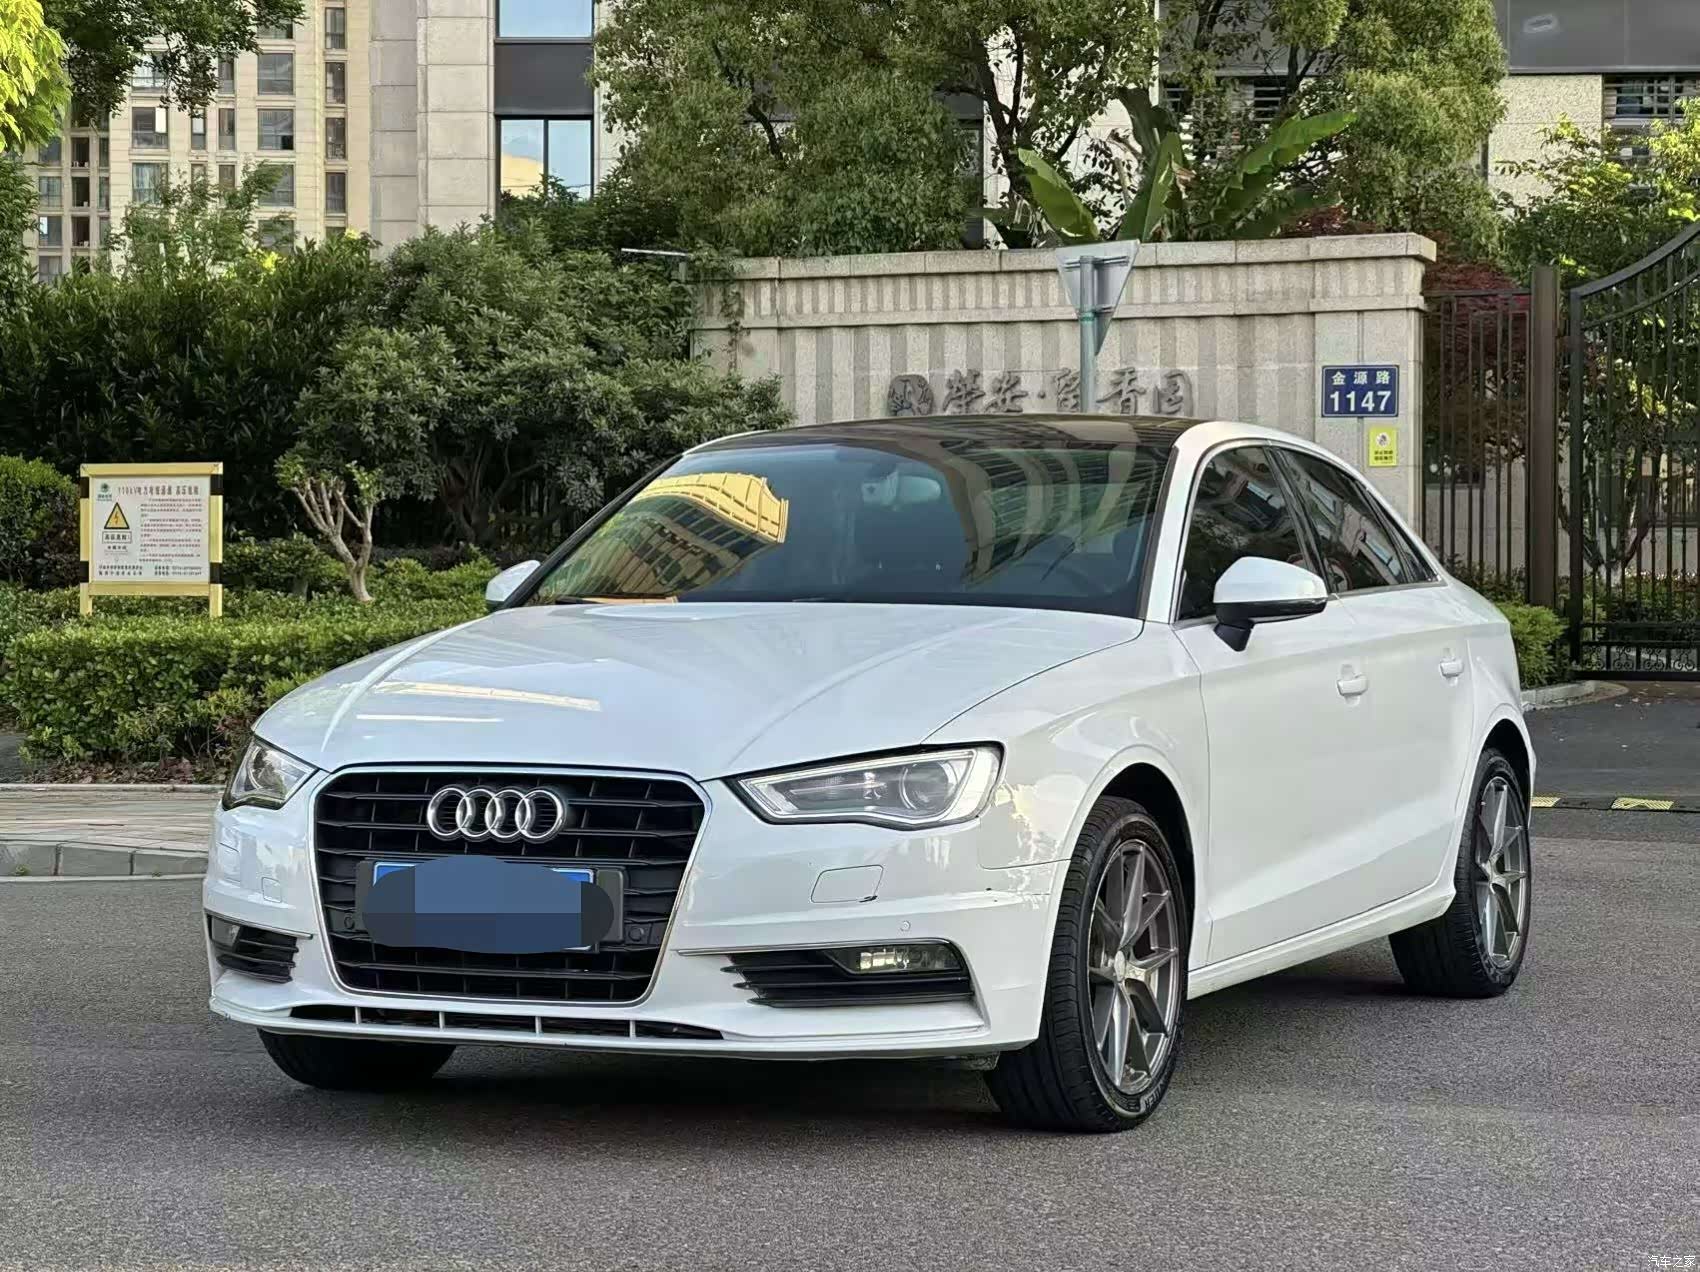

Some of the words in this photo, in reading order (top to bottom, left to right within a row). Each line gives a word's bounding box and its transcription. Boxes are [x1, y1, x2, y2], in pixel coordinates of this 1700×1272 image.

[1331, 371, 1391, 386] 金源路
[1329, 390, 1392, 412] 1147
